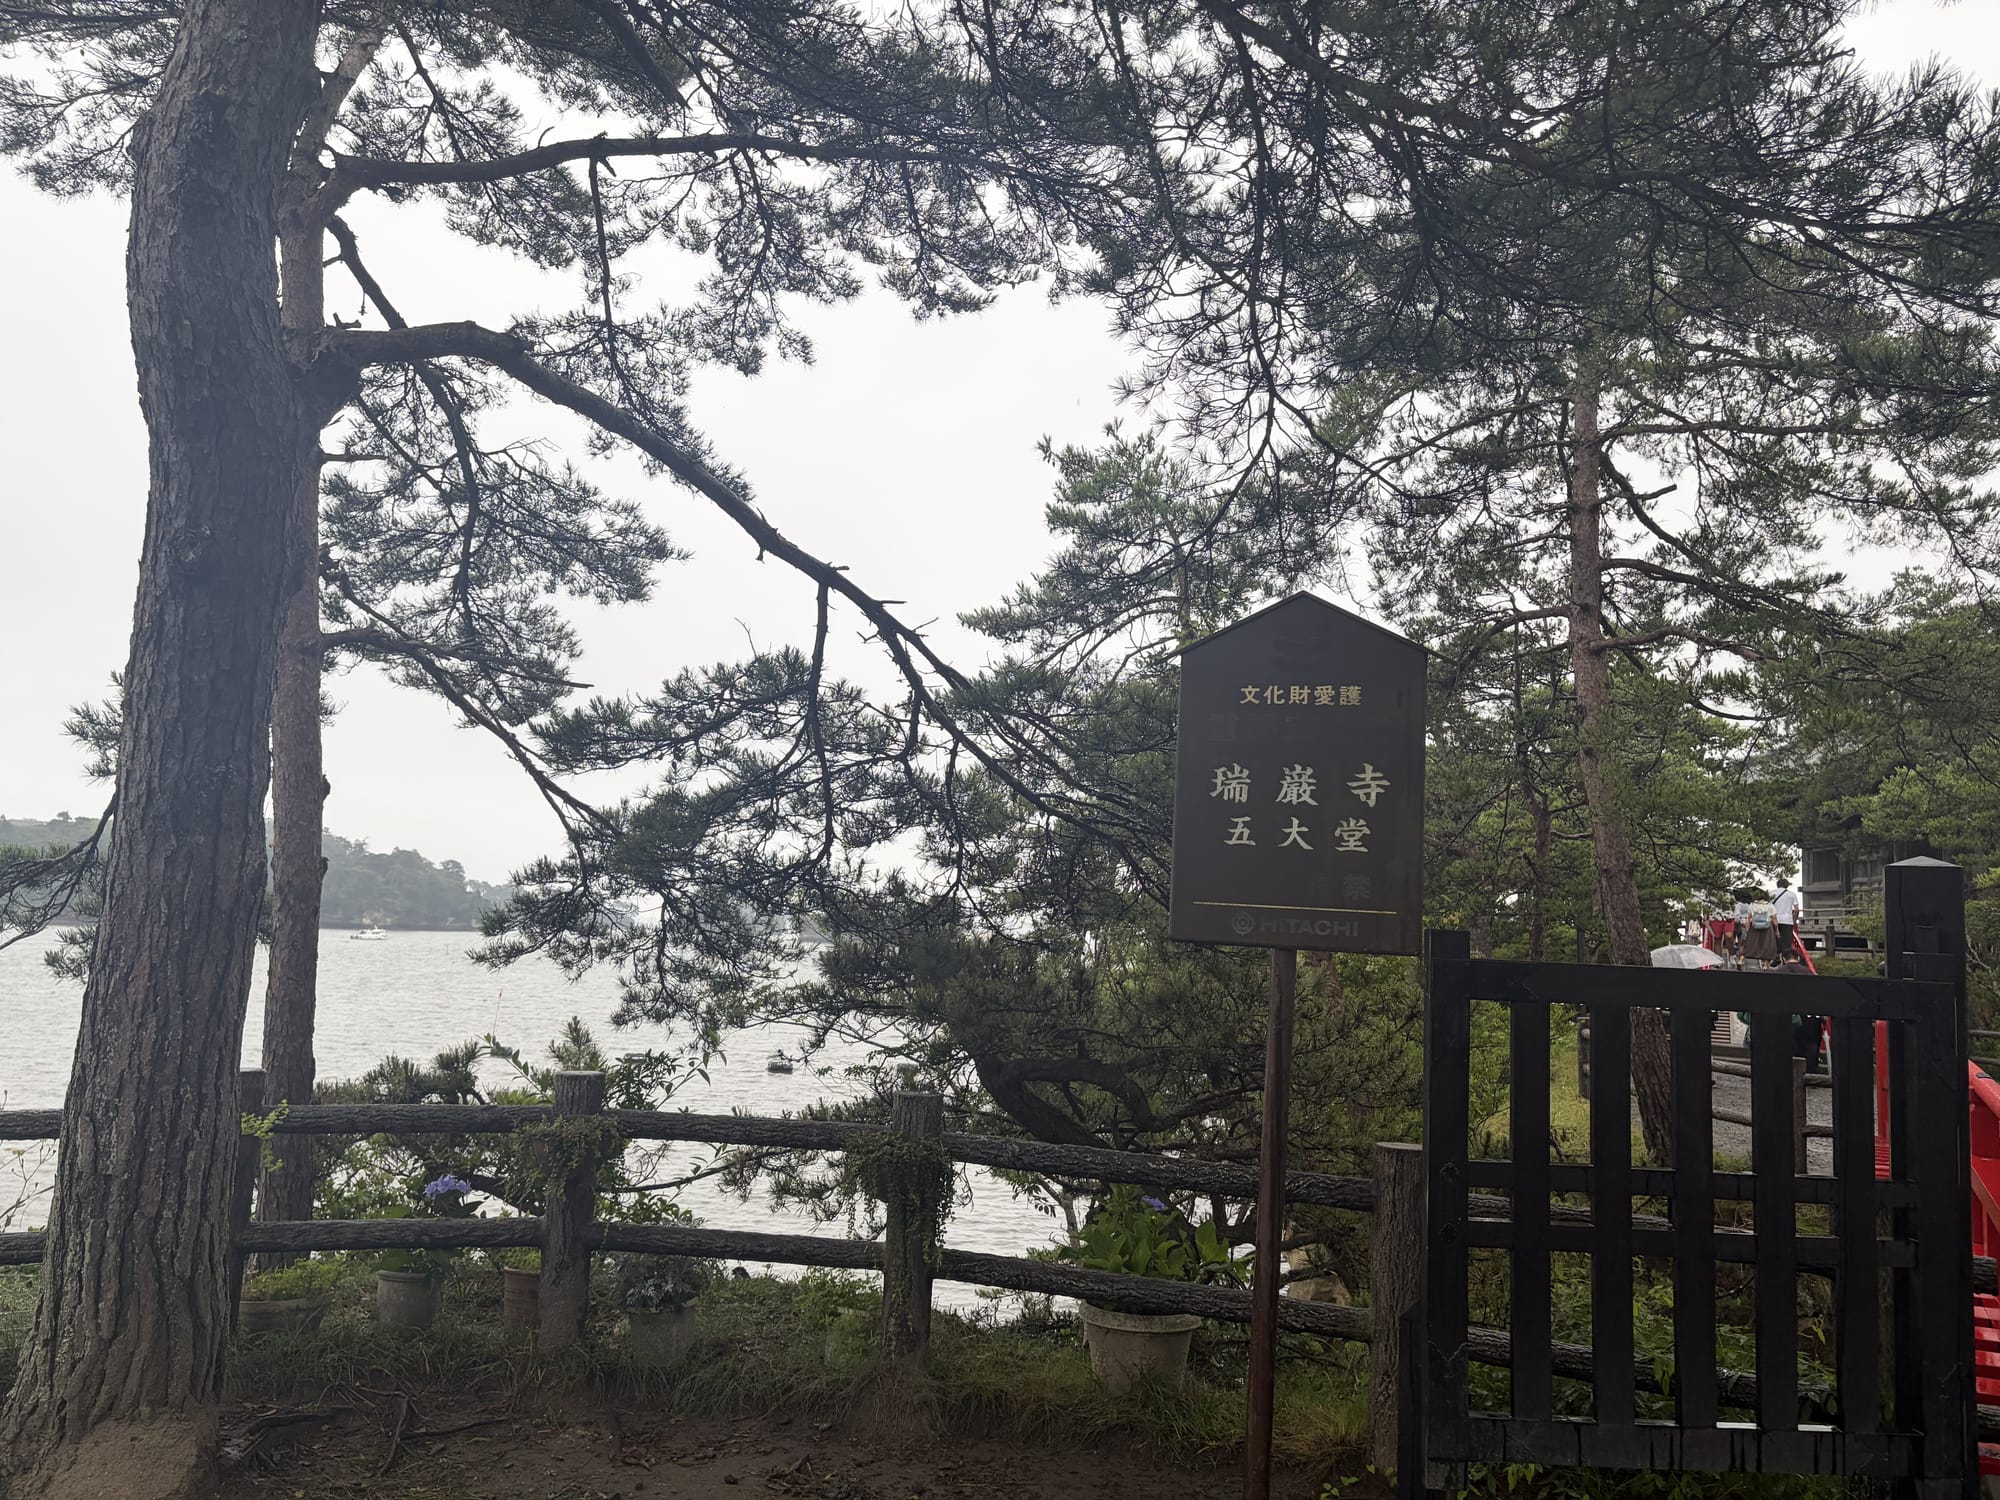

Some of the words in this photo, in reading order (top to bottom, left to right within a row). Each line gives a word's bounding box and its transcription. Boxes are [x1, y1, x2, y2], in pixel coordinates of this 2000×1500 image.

[1239, 685, 1362, 706] 文化財愛護
[1224, 816, 1371, 852] 五大堂
[1260, 918, 1359, 937] HITACHI
